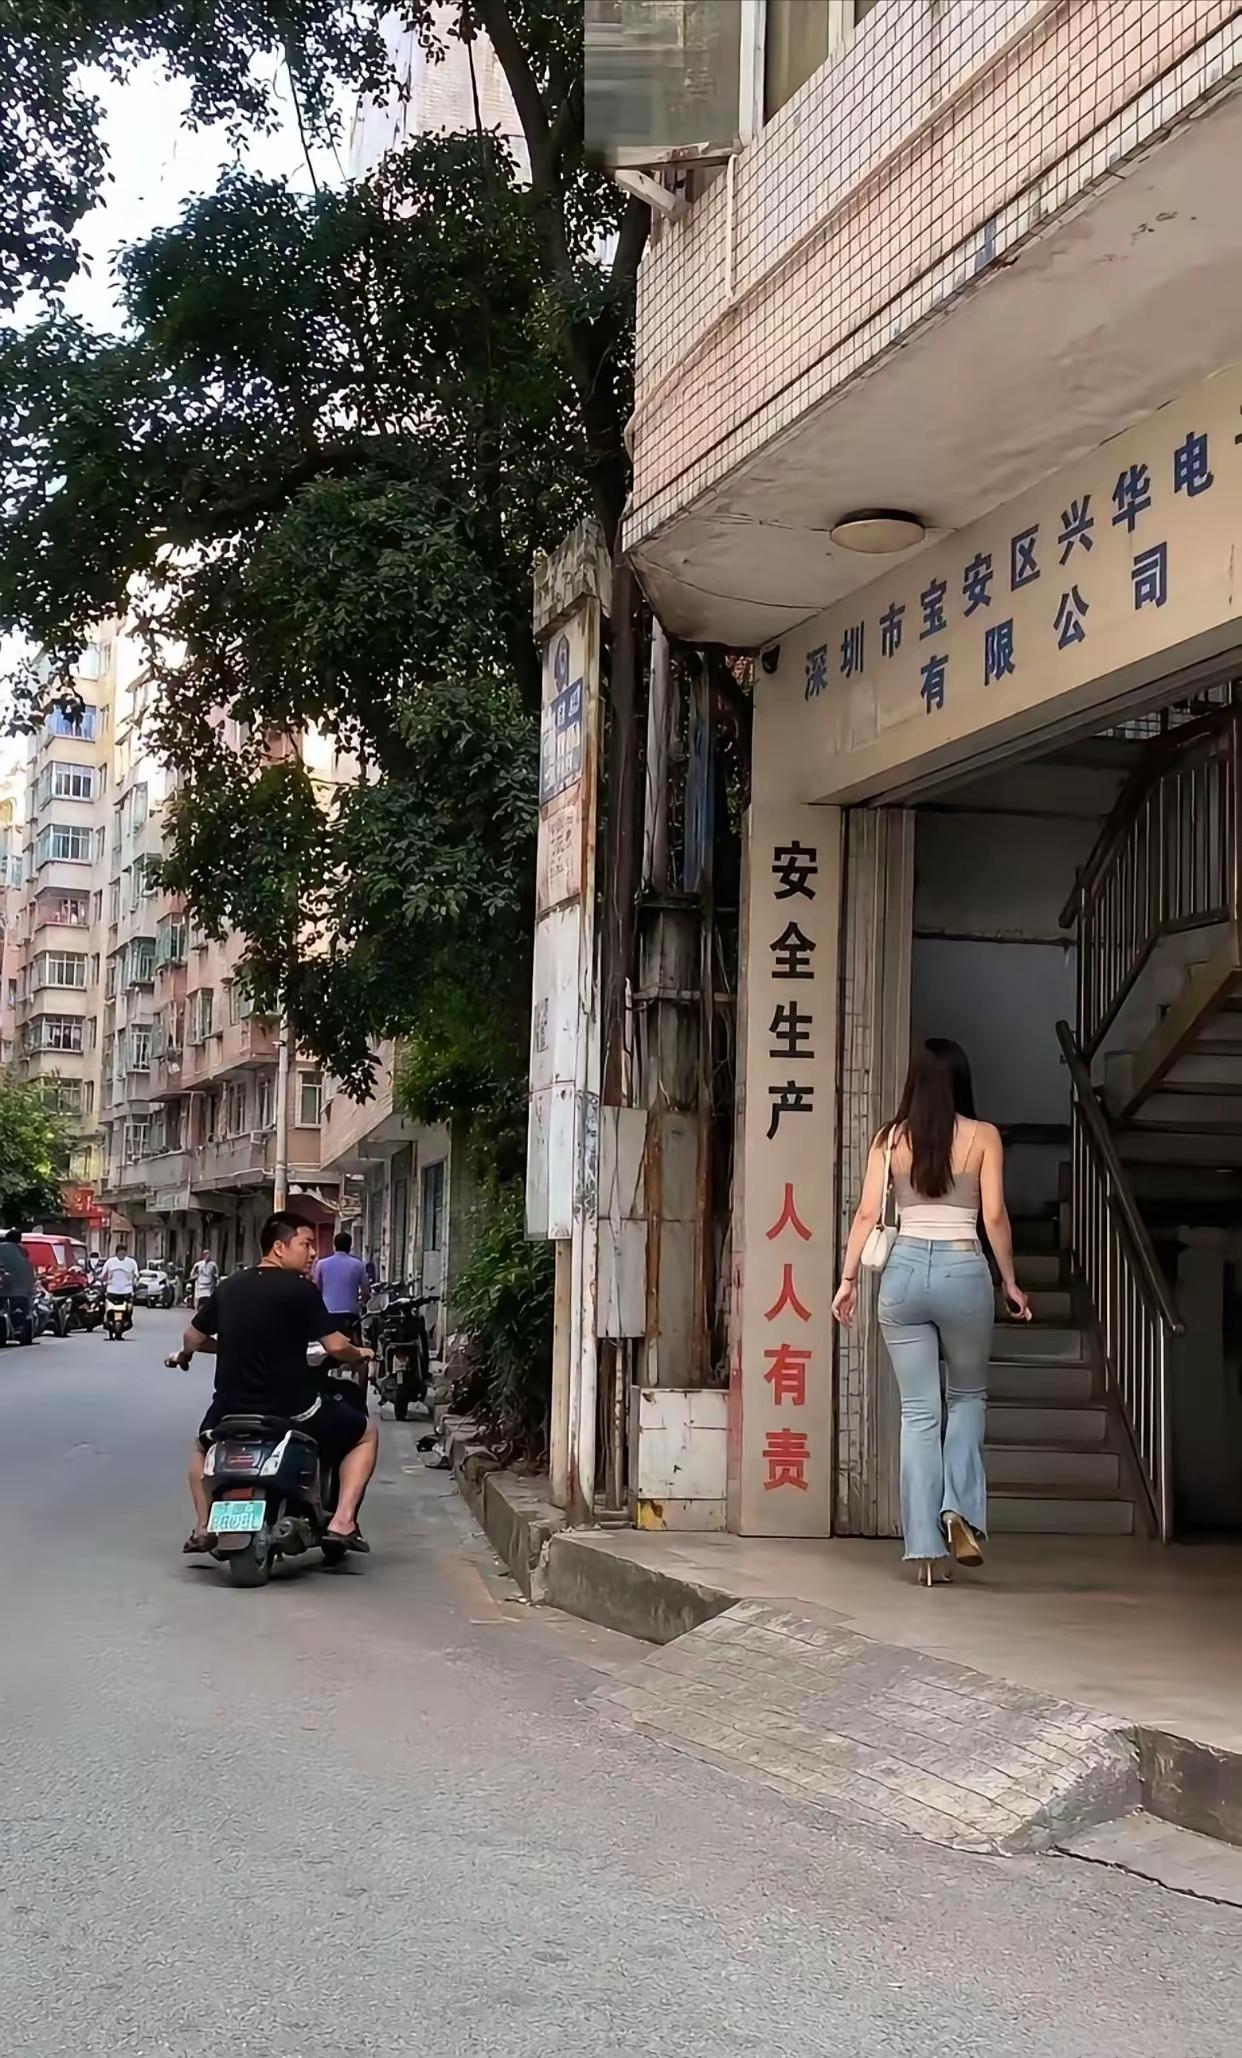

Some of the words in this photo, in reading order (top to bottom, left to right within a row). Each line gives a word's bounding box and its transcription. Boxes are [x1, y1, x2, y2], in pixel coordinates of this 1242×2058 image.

[804, 404, 1242, 701] 深圳市宝安区兴华电
[920, 542, 1167, 714] 有限公司
[766, 840, 818, 1139] 安全生产
[762, 1182, 812, 1491] 人人有责
